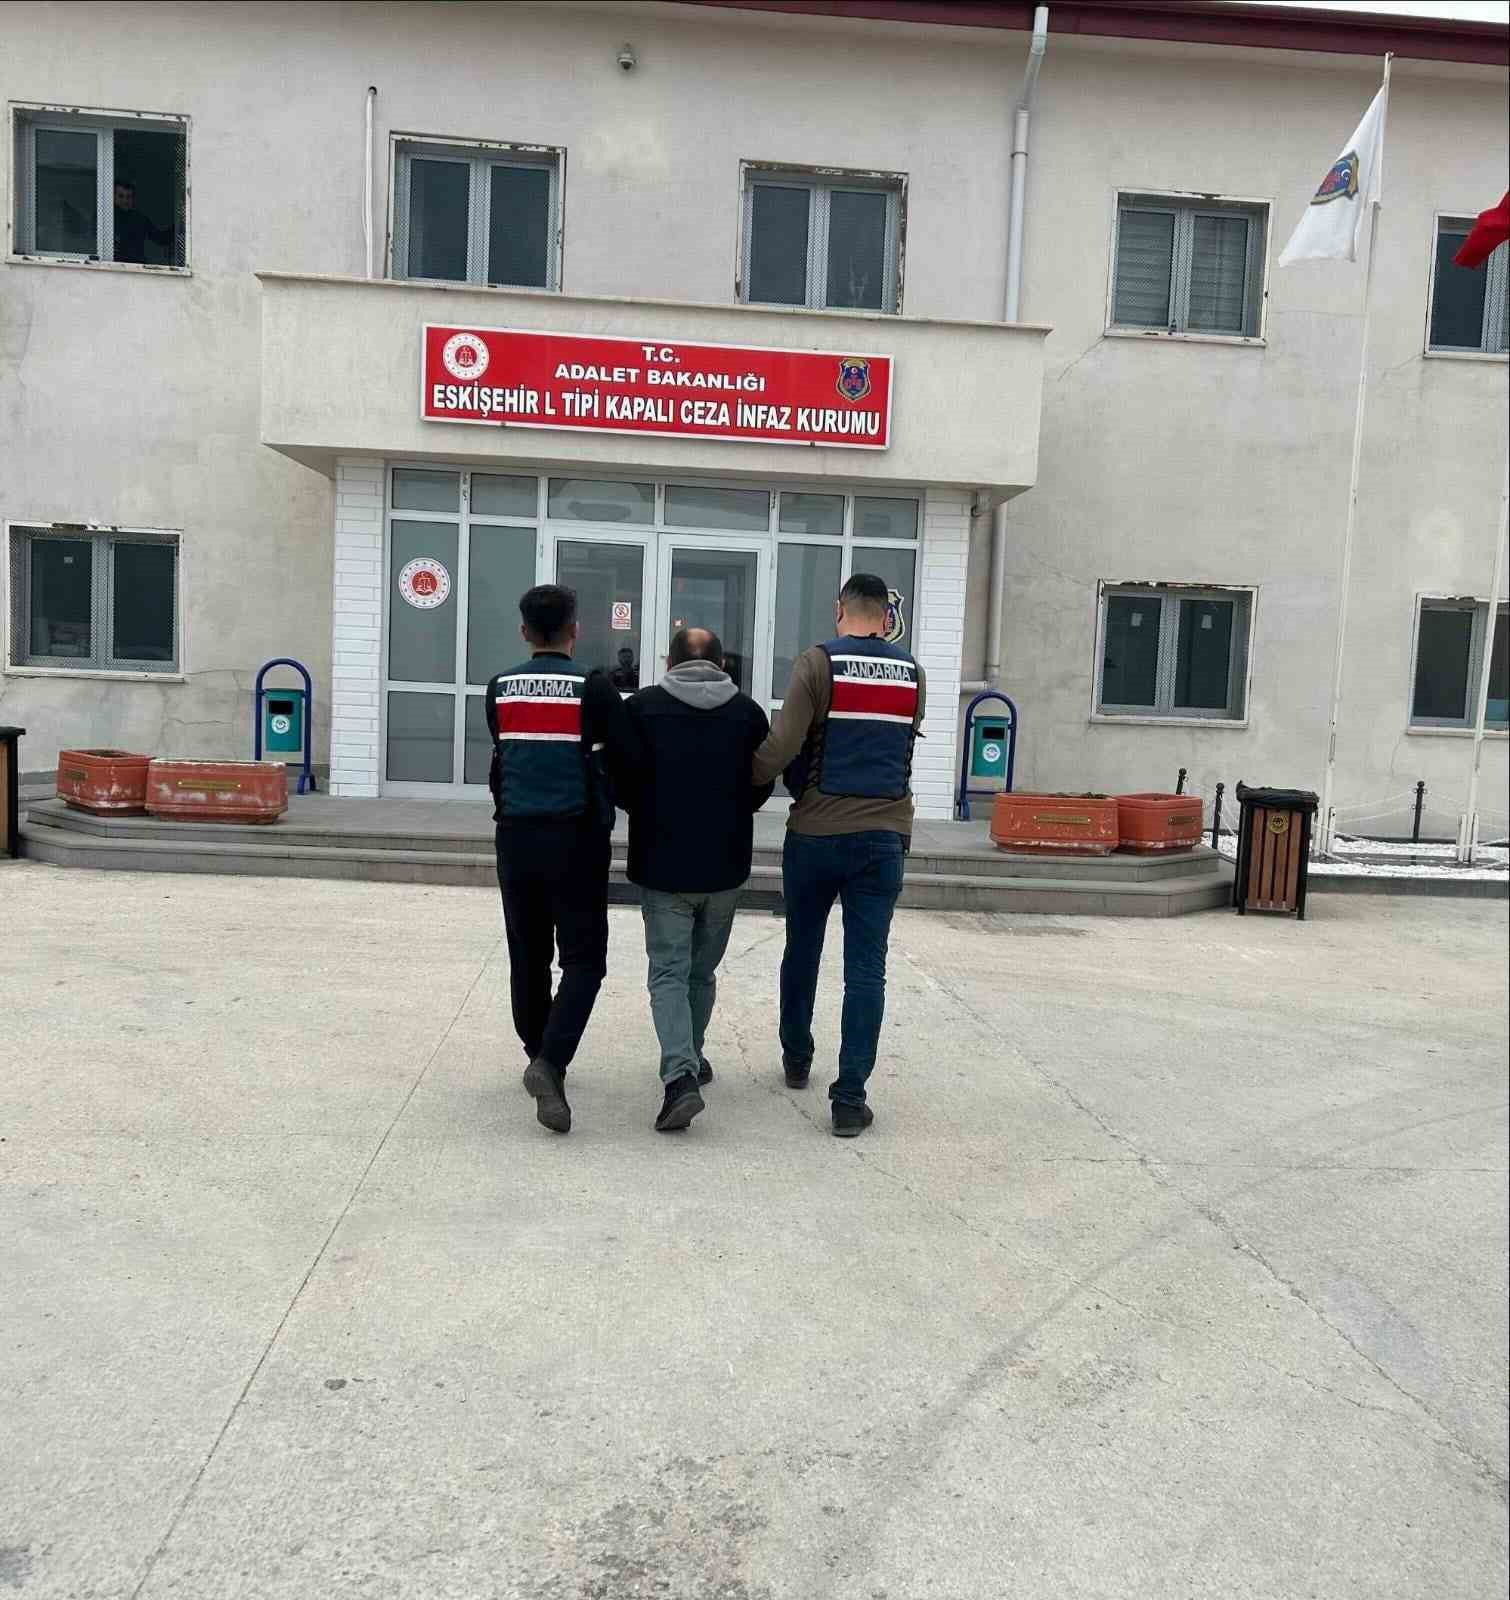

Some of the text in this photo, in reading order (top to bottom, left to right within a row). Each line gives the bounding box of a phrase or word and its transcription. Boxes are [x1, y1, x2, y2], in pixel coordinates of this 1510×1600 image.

[642, 346, 681, 364] T.C.
[555, 364, 766, 392] ADALET BAKANLIĞI
[433, 381, 880, 436] ESKİŞEHİR L TİPİ KAPALI CEZA İNFAZ KURUMU
[843, 660, 911, 681] JANDARMA
[502, 679, 575, 697] JANDARMA
